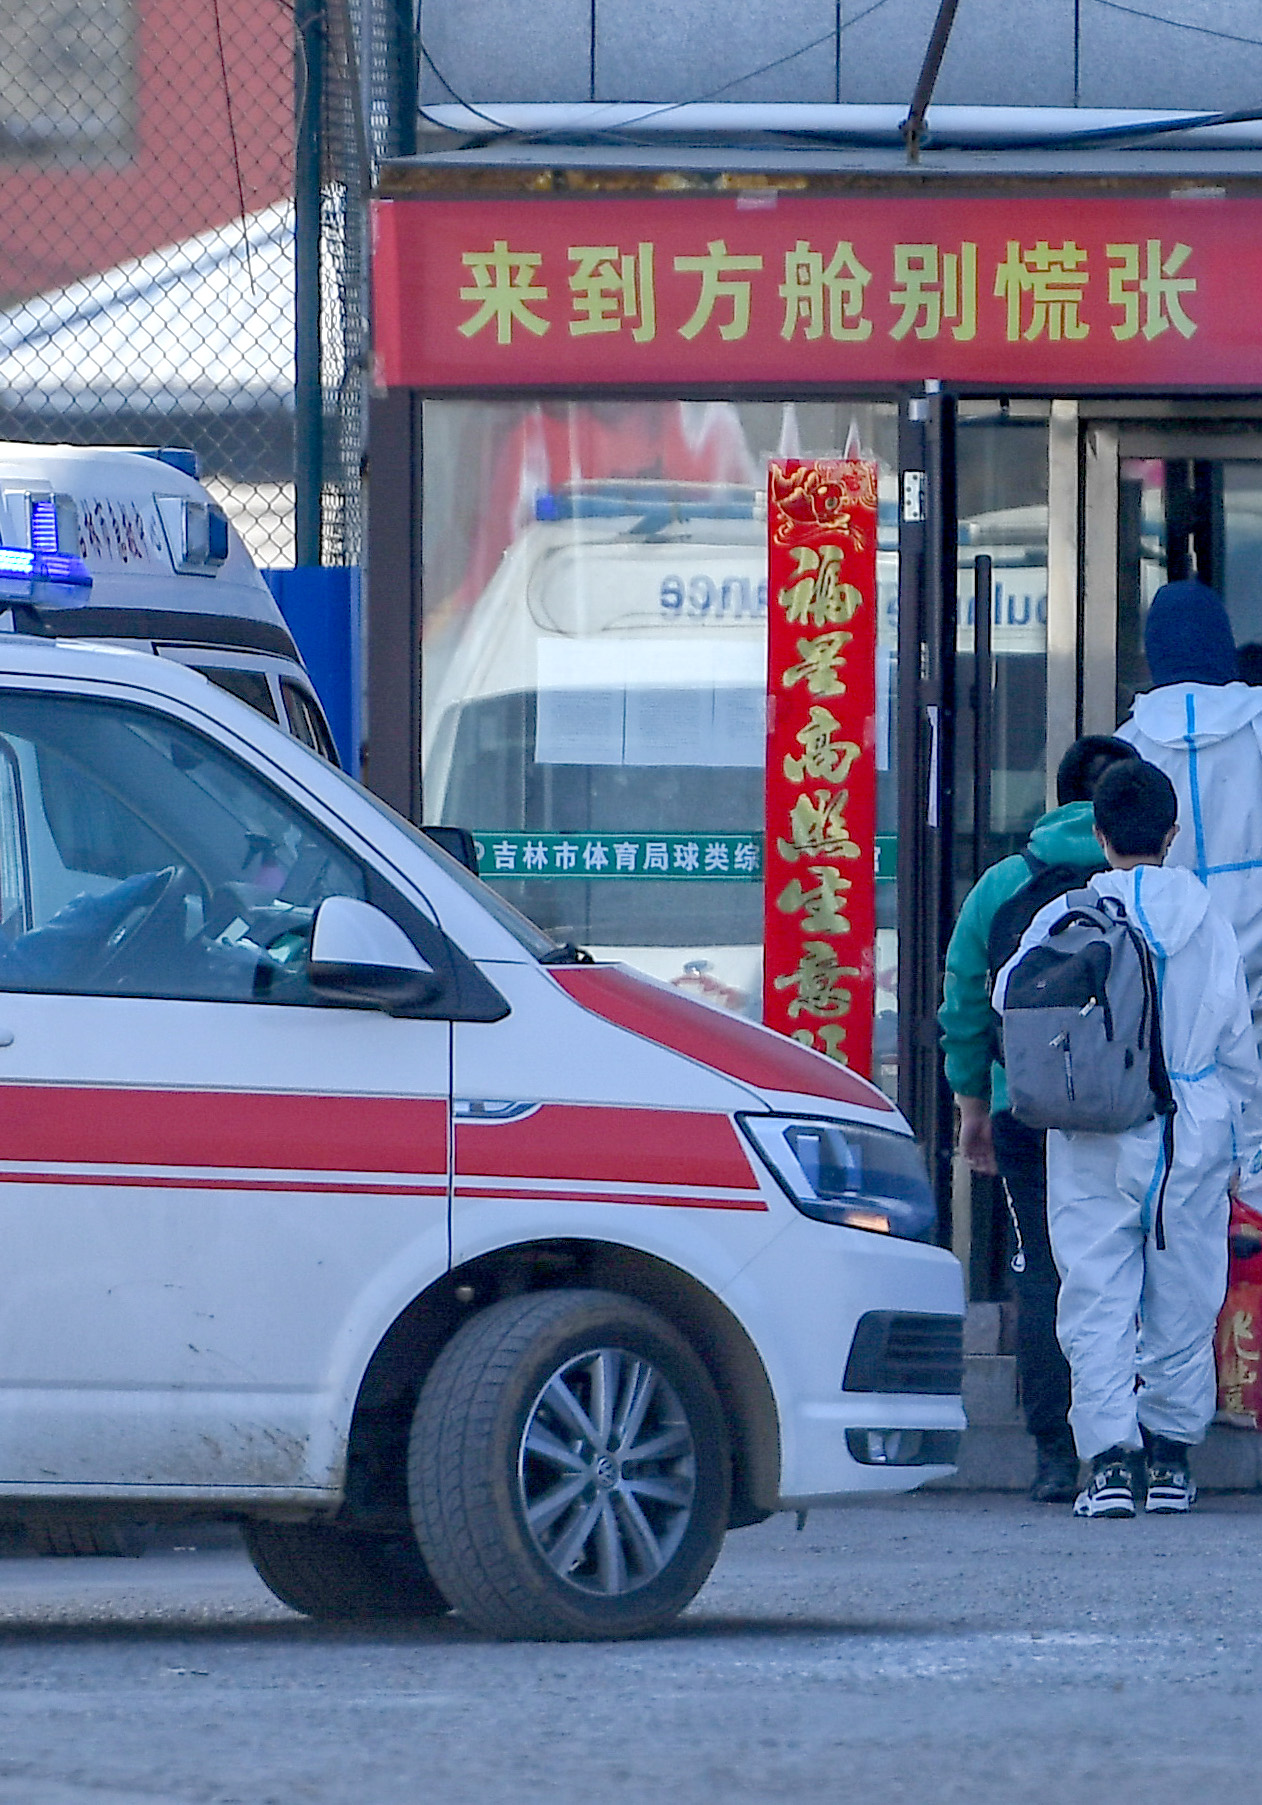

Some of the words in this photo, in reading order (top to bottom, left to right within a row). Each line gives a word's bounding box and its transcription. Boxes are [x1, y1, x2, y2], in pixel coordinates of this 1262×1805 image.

[457, 239, 1198, 345] 来到方舱别慌张
[492, 840, 760, 871] 吉林市体育局球类综
